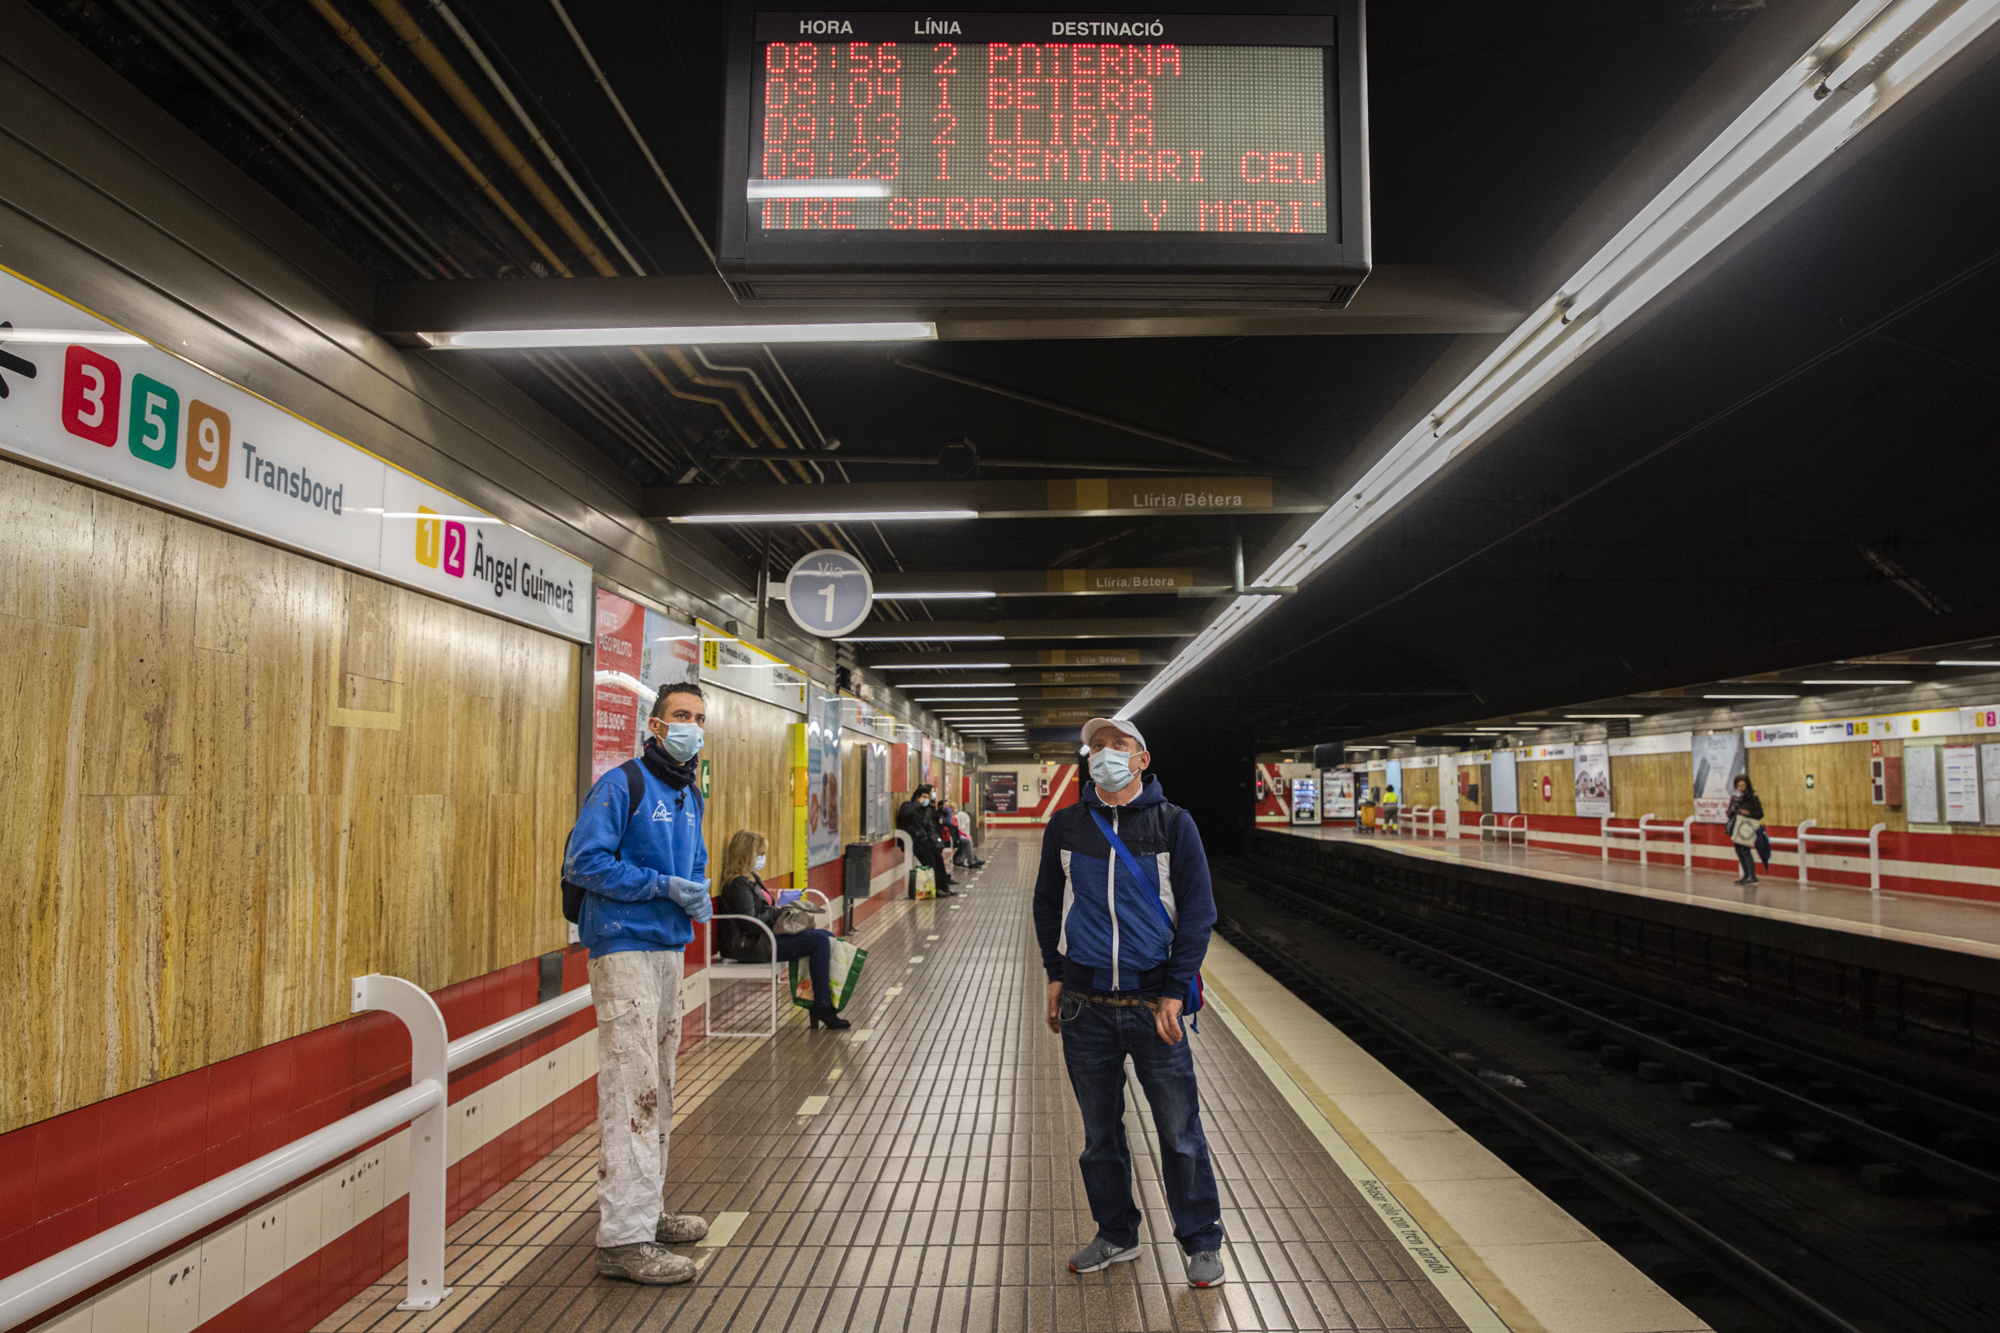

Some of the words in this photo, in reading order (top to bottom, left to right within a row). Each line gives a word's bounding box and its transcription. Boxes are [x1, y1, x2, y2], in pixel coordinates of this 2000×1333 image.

[799, 20, 853, 34] HORA
[914, 17, 962, 35] LÍNIA
[1051, 18, 1164, 36] DESTINACIÓ
[766, 42, 901, 74] 08:56
[933, 42, 957, 74] 2
[765, 78, 900, 109] 09:04
[937, 78, 951, 109] 1
[988, 78, 1153, 111] BETERA
[764, 113, 900, 144] 09:13
[932, 113, 956, 144] 2
[988, 113, 1153, 146] LLIRIA
[762, 148, 900, 180] 09:23
[936, 149, 951, 180] 1
[988, 149, 1204, 182] SEMINARI
[1241, 151, 1321, 185] CEU
[889, 197, 1111, 231] SERRERIA
[1143, 199, 1167, 231] Y
[77, 364, 106, 428] 3
[142, 391, 168, 451] 5
[197, 417, 220, 472] 9
[241, 441, 343, 516] Transbord
[1133, 492, 1242, 508] Llíria/Bétera
[424, 519, 433, 558] 1
[448, 528, 461, 569] 2
[473, 528, 518, 598] Àngel
[521, 562, 574, 614] Guimerà
[818, 562, 843, 578] Via
[818, 584, 835, 622] 1
[599, 608, 618, 630] VISITE
[598, 633, 613, 654] PISO
[612, 638, 633, 658] PILOTO
[1378, 1203, 1402, 1216] solo
[1390, 1217, 1410, 1229] con
[1401, 1230, 1424, 1245] tren
[1408, 1247, 1451, 1274] parado
